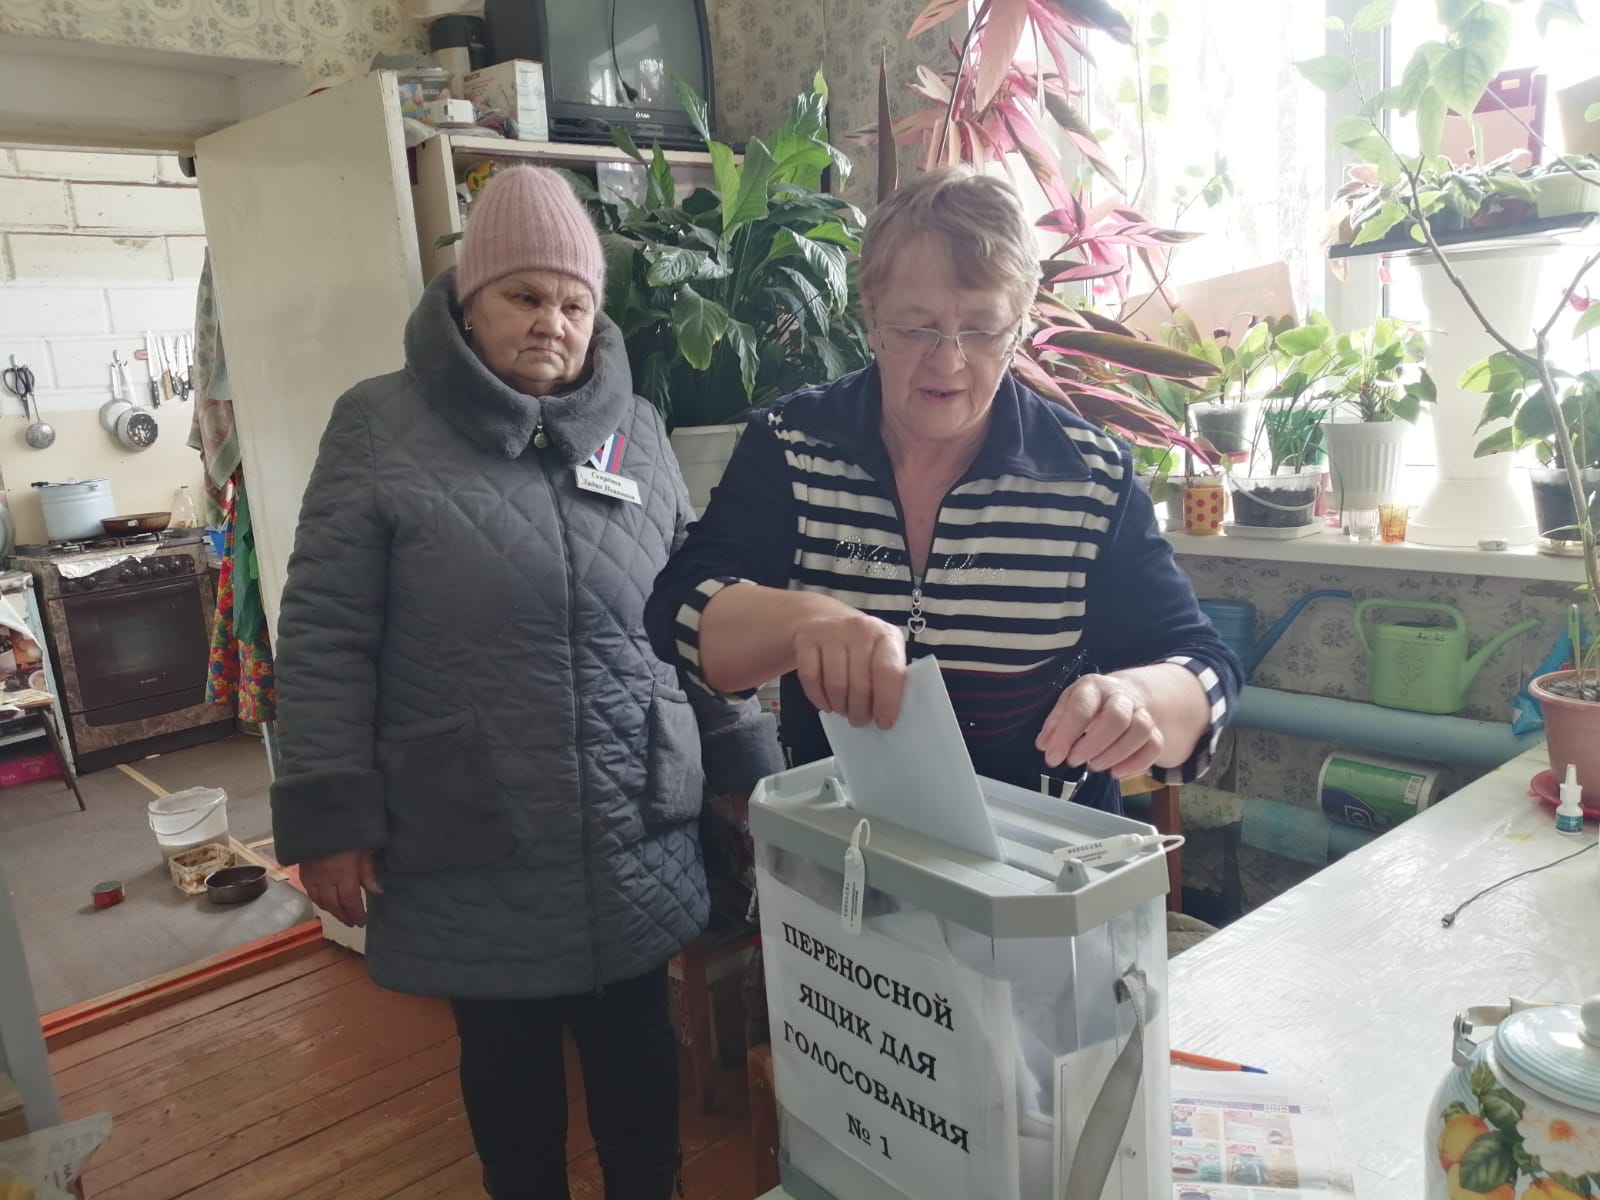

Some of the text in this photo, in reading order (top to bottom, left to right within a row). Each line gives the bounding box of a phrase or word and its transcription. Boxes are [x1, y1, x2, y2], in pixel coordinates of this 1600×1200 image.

[782, 921, 954, 1032] ПЕРЕНОСНОЙ
[799, 983, 937, 1082] ЯЩИК ДЛЯ
[783, 1020, 970, 1154] ГОЛОСОВАНИЯ
[846, 1112, 893, 1160] № 1
